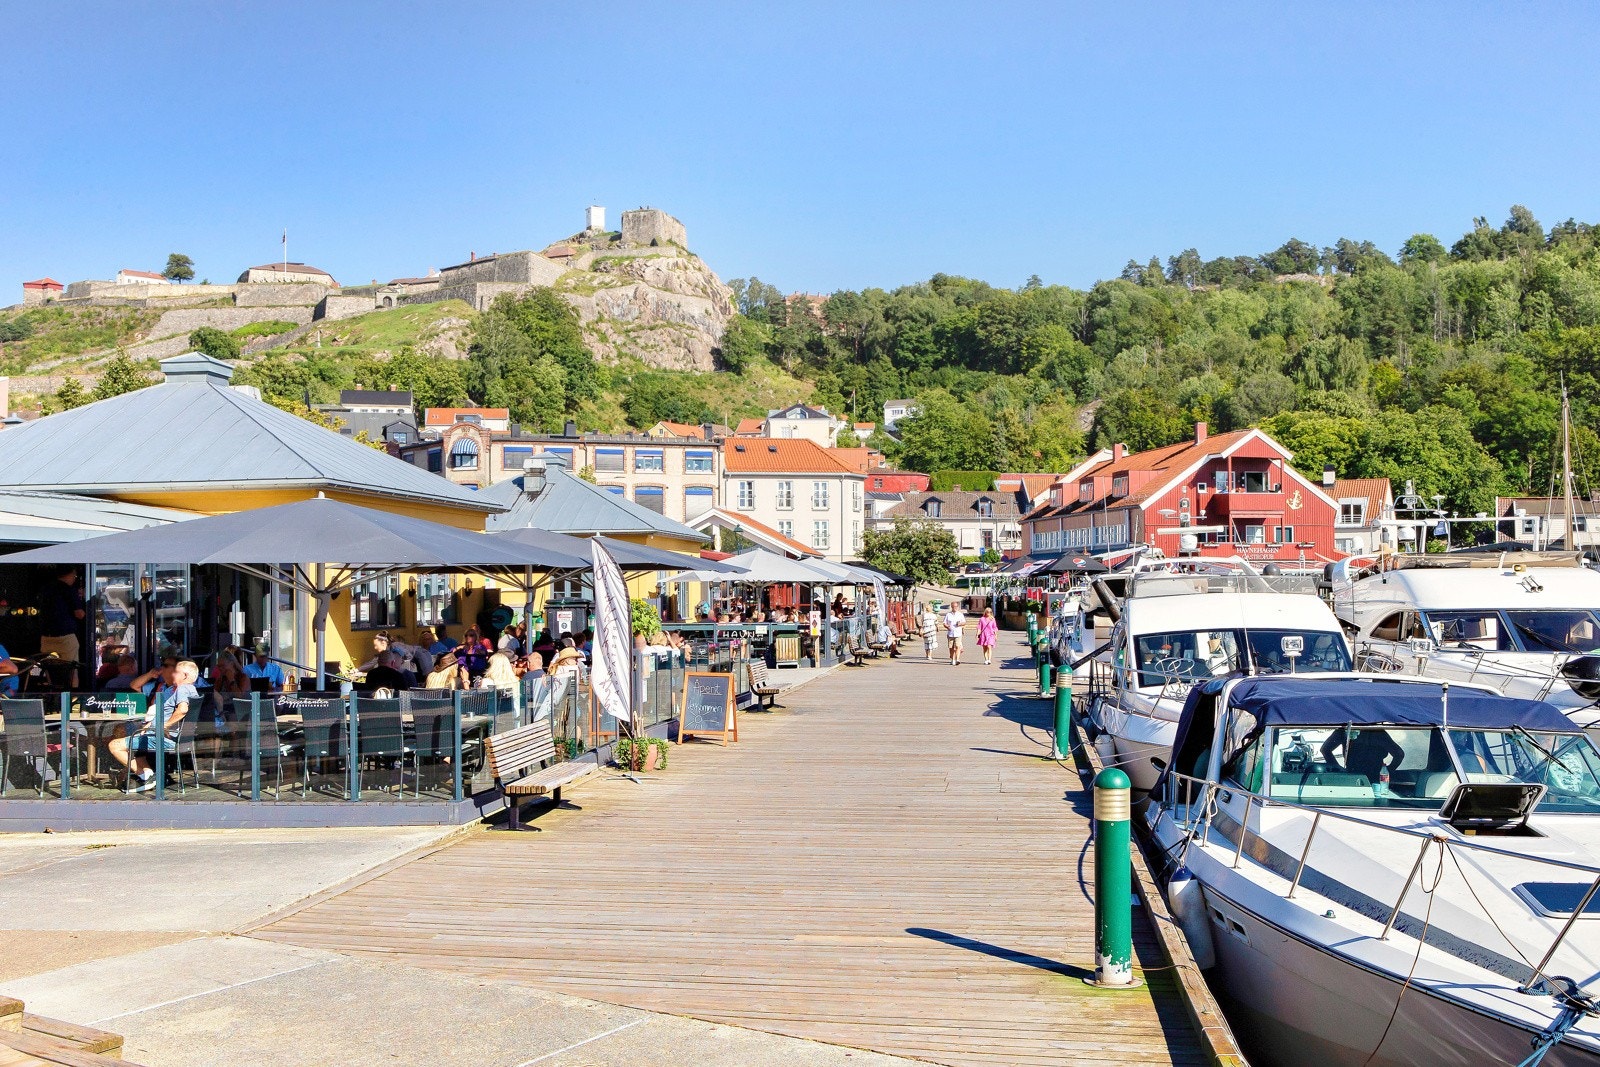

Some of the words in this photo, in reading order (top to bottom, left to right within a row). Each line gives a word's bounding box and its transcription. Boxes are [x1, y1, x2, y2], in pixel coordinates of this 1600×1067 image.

[693, 679, 721, 696] Åpent
[86, 696, 136, 709] Bryggekanten
[276, 695, 329, 709] Bryggekanten
